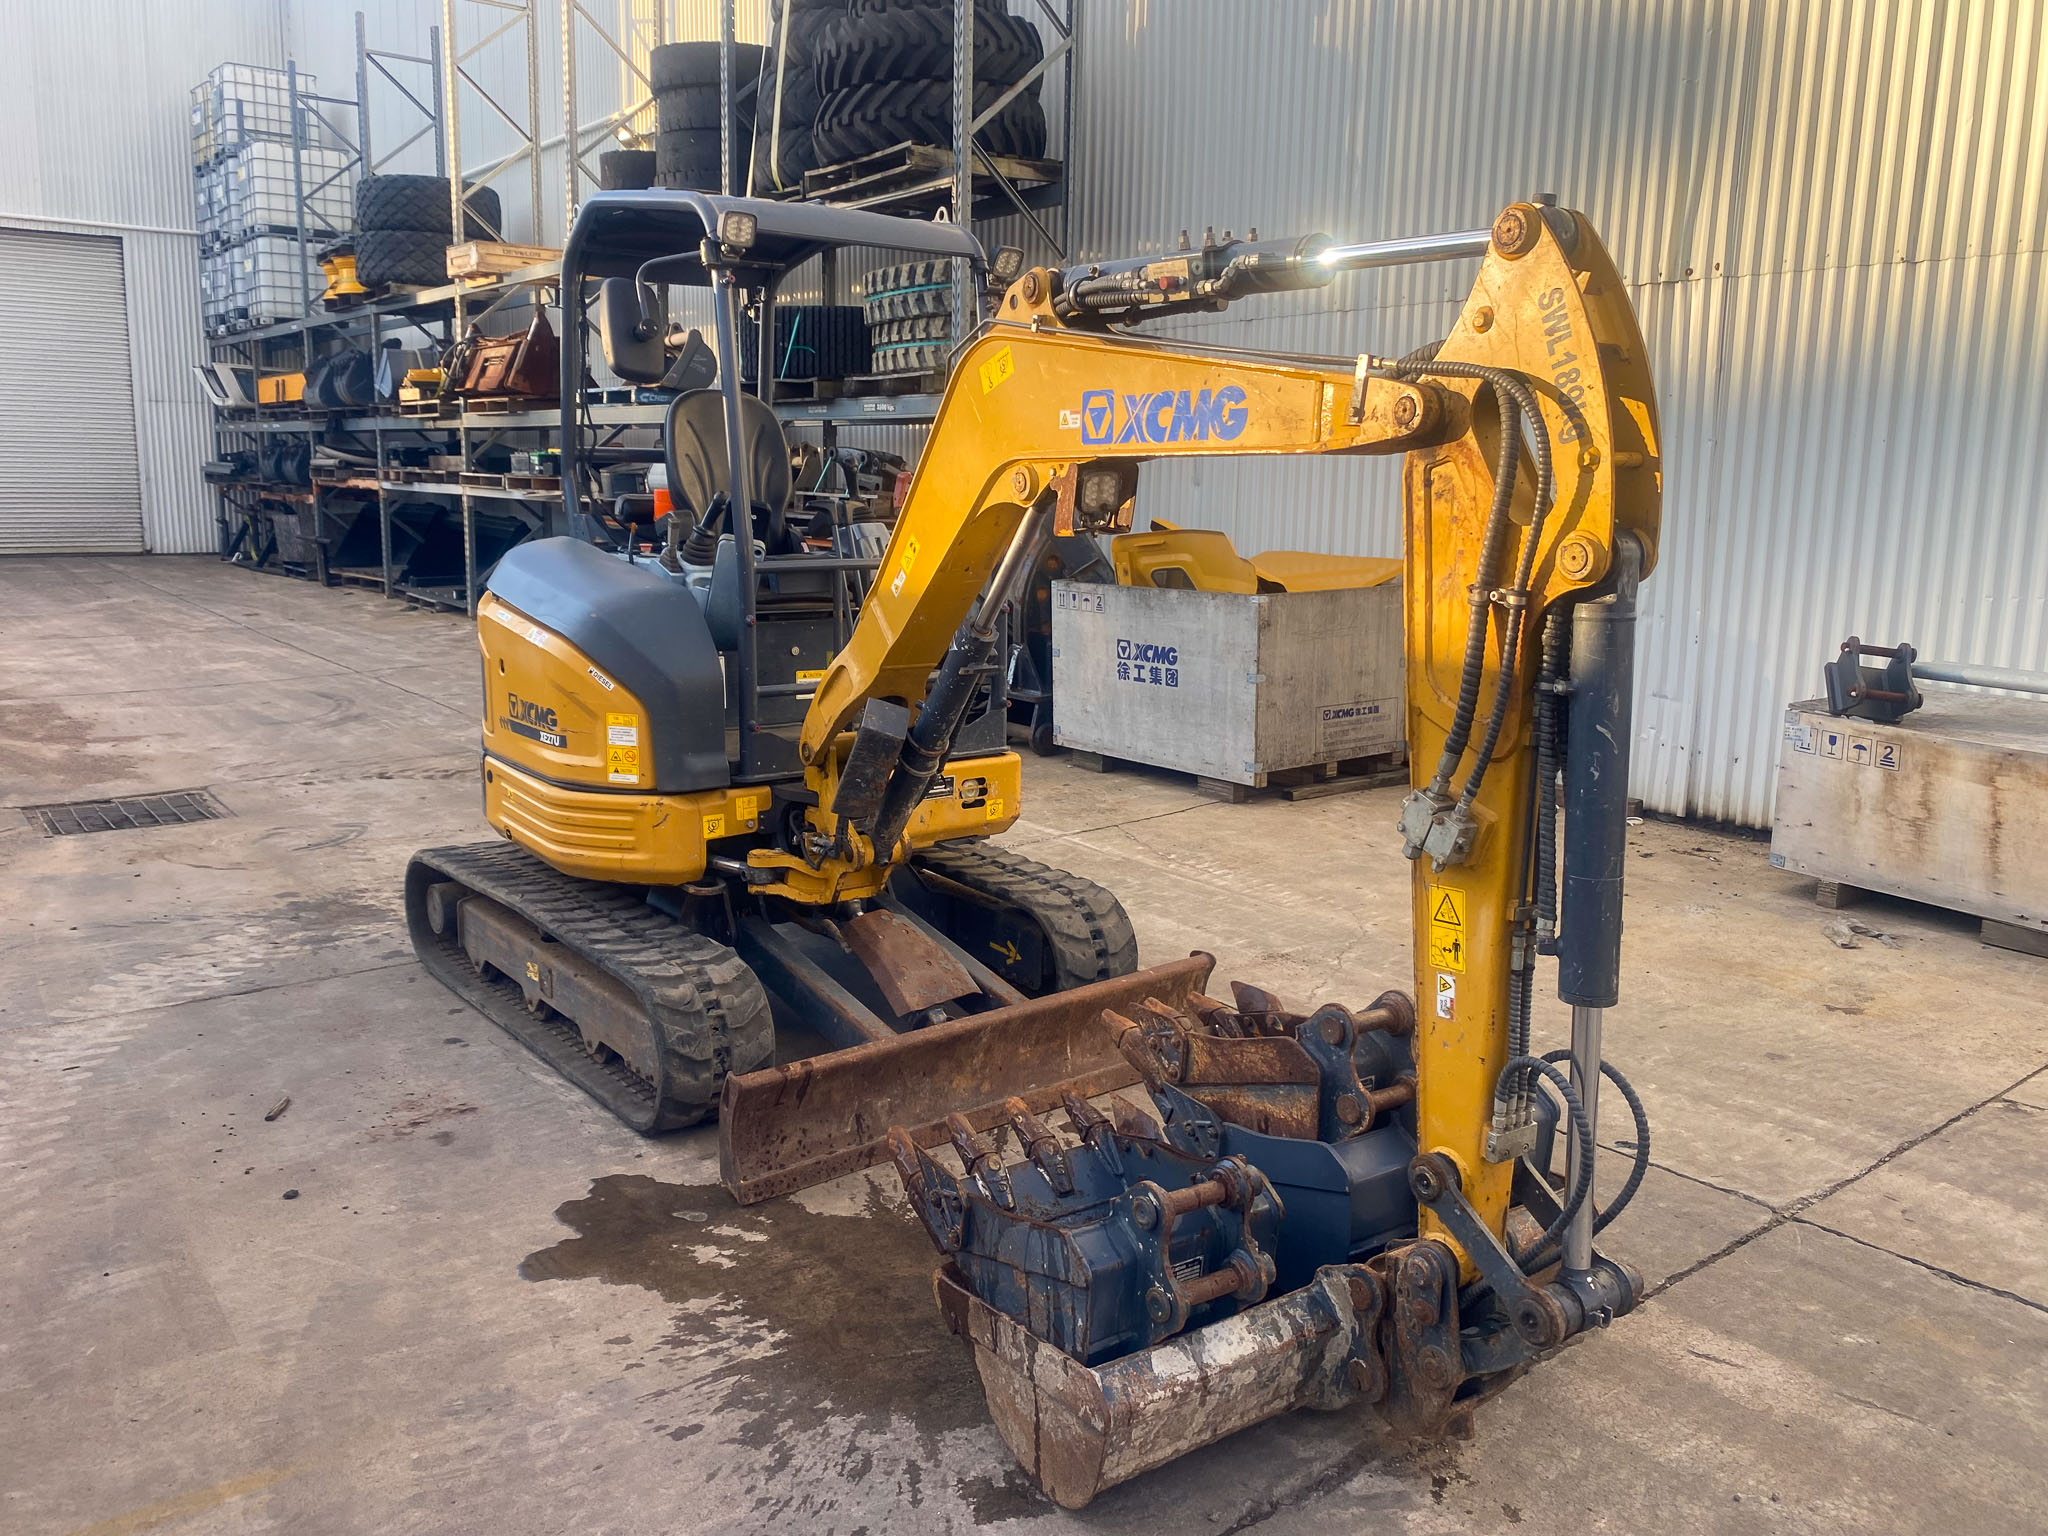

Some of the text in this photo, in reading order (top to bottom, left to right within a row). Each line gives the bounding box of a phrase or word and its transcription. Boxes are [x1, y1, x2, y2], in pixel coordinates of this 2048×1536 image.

[1538, 287, 1573, 357] SWL
[1114, 385, 1249, 445] XCMG
[1096, 595, 1103, 607] 2
[1131, 642, 1178, 666] XCMG
[592, 671, 613, 690] DIESEL
[1116, 661, 1179, 688] 徐工集团
[519, 699, 558, 729] XCMG
[1883, 745, 1894, 761] 2
